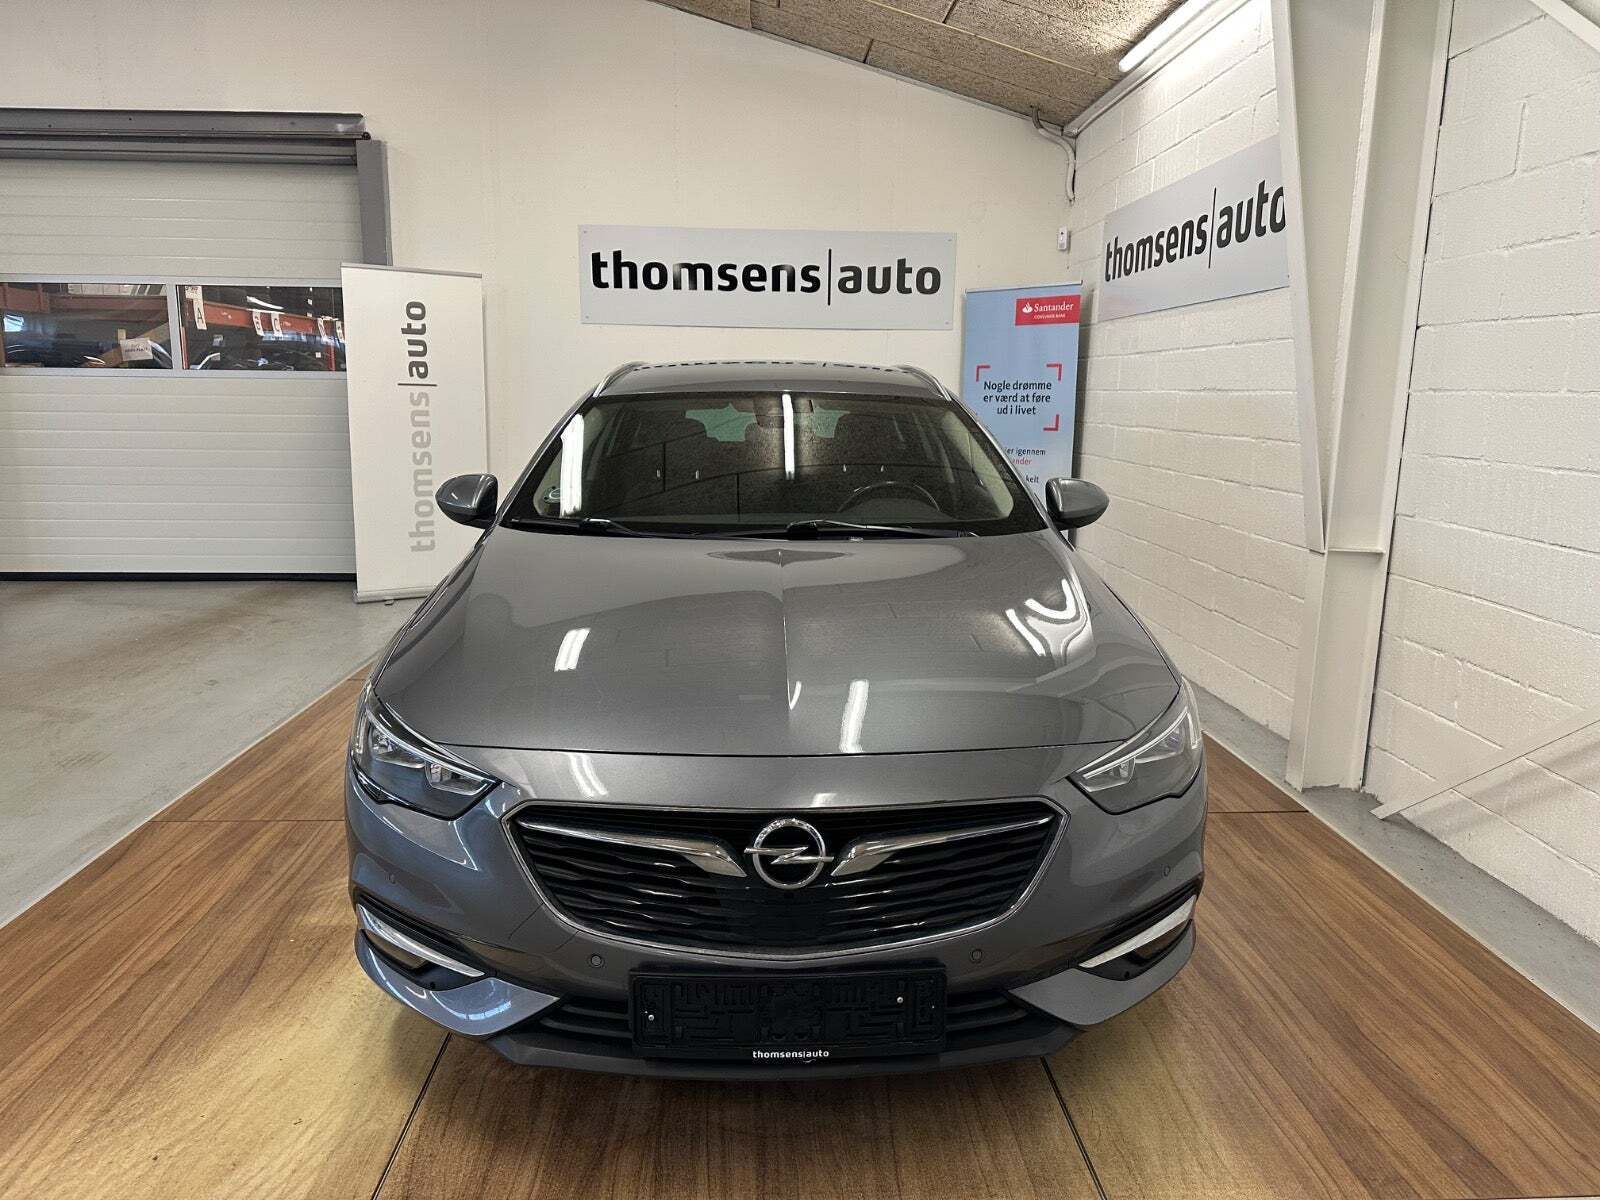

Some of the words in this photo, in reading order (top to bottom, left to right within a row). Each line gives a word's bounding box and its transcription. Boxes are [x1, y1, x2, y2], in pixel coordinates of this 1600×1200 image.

[1033, 301, 1074, 313] Santander
[983, 380, 1010, 393] Nogle
[1012, 380, 1052, 391] drømme
[983, 394, 993, 402] er
[995, 392, 1018, 402] værd
[1020, 393, 1029, 402] at
[1031, 392, 1051, 403] føre
[997, 405, 1008, 415] ud
[1015, 405, 1036, 415] livet
[1015, 447, 1046, 456] igennem
